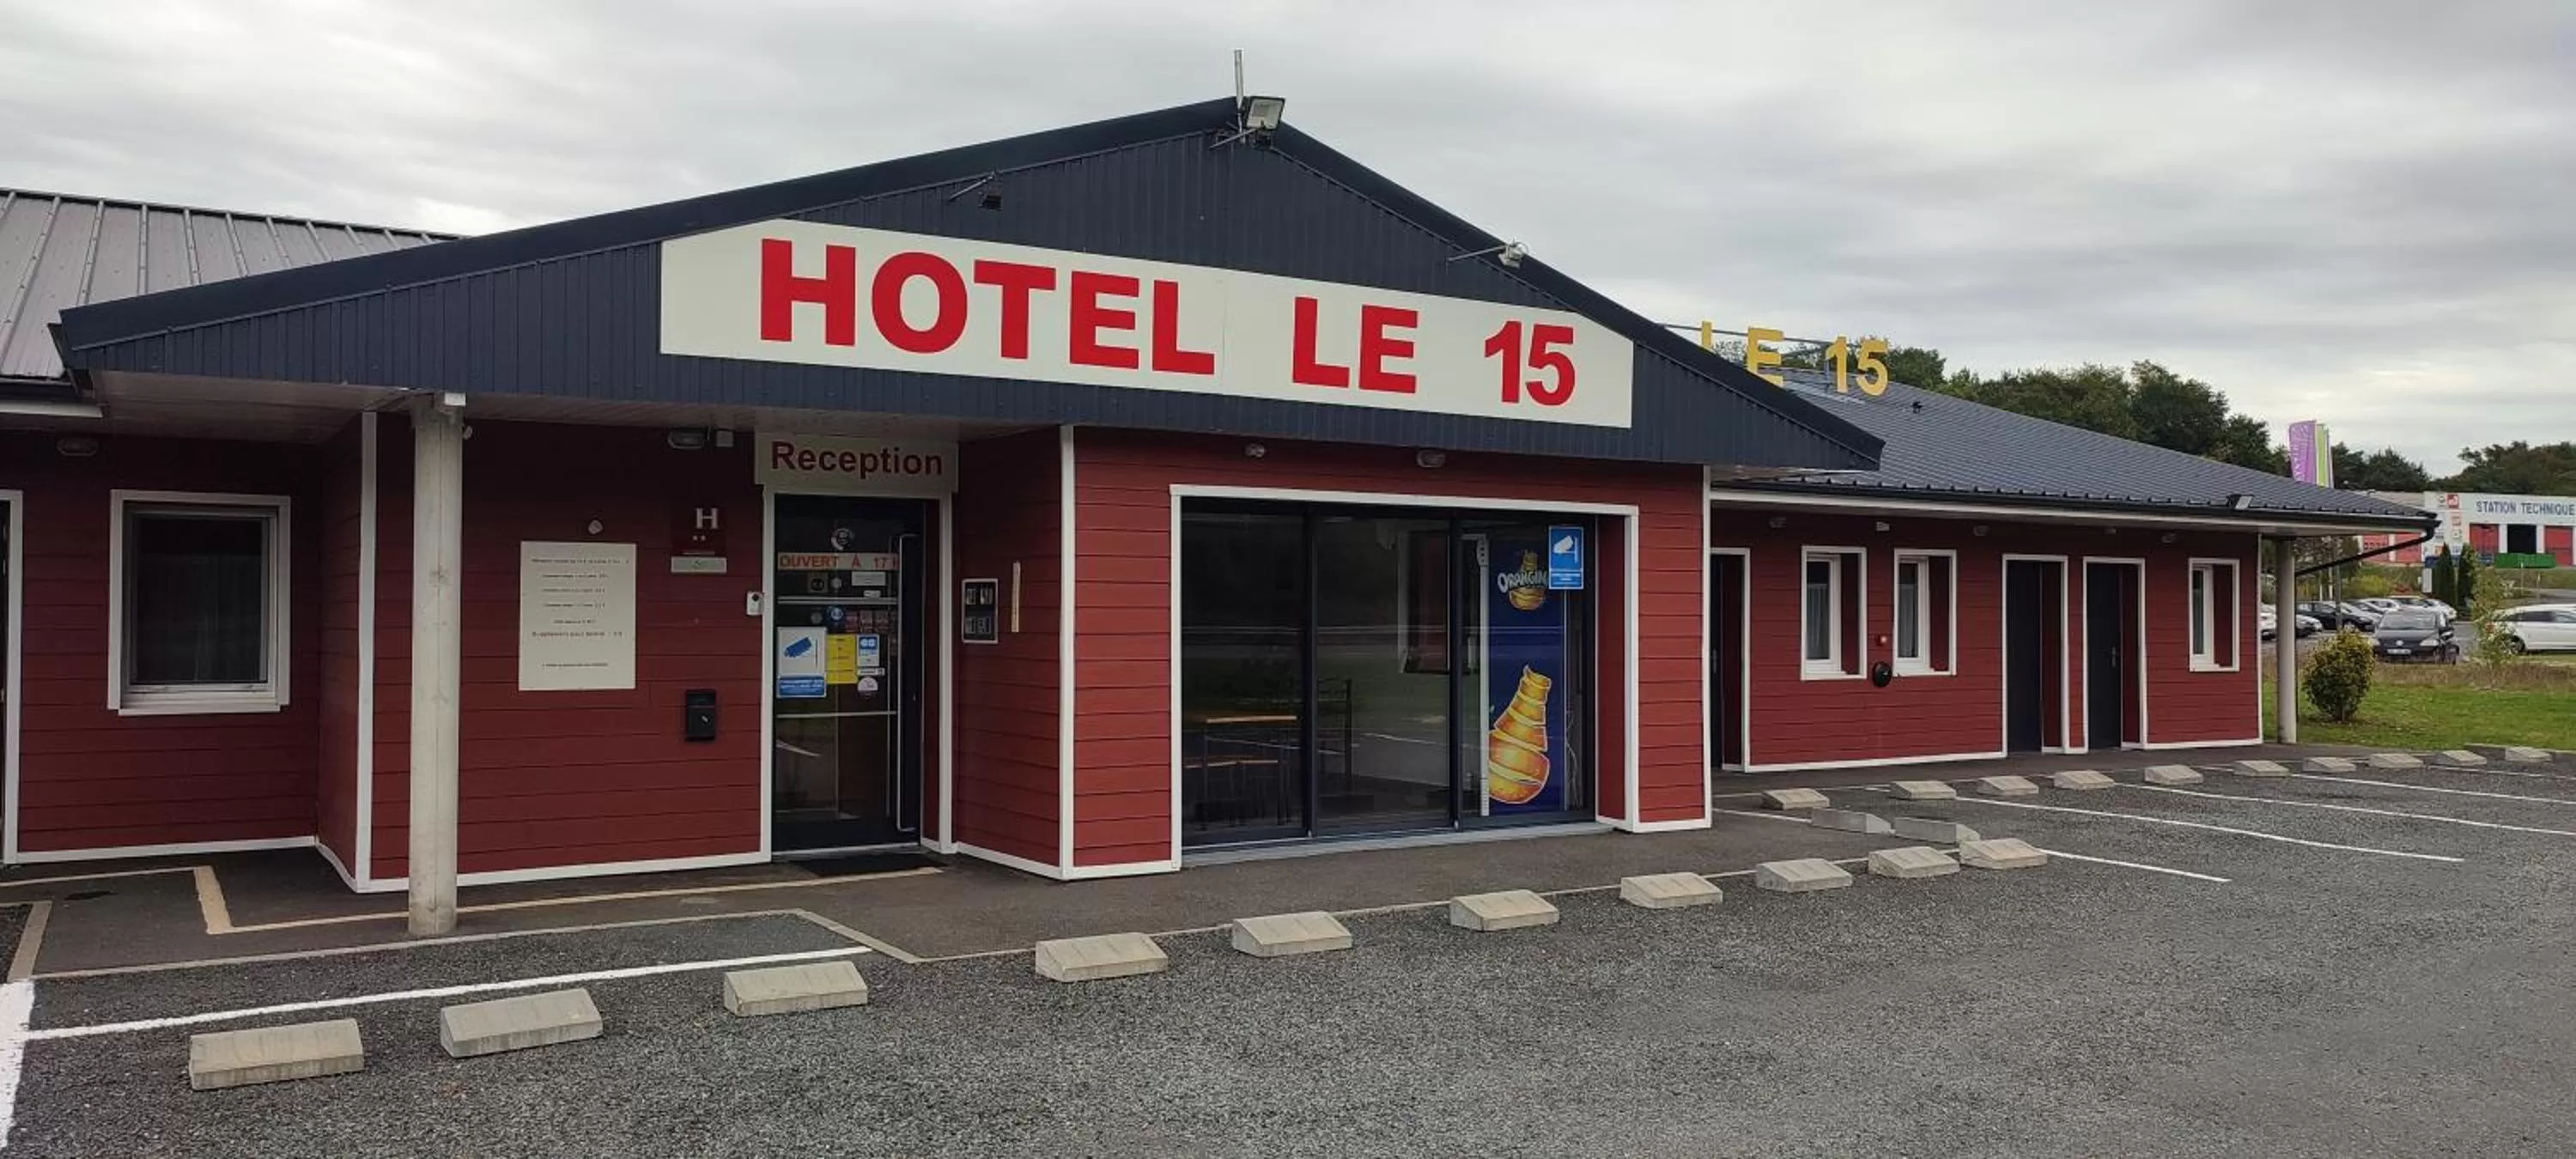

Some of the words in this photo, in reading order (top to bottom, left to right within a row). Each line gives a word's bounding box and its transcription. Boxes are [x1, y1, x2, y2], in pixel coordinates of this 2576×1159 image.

[761, 238, 1215, 375] HOTEL
[1291, 296, 1419, 394] LE
[1484, 320, 1576, 407] 15
[1826, 336, 1889, 396] 15
[771, 441, 943, 479] Reception
[694, 507, 719, 529] H
[2476, 501, 2517, 513] STATION
[2521, 502, 2575, 516] TECHNIQUE
[779, 555, 839, 567] OUVERT
[1498, 570, 1548, 593] ORANGIN
